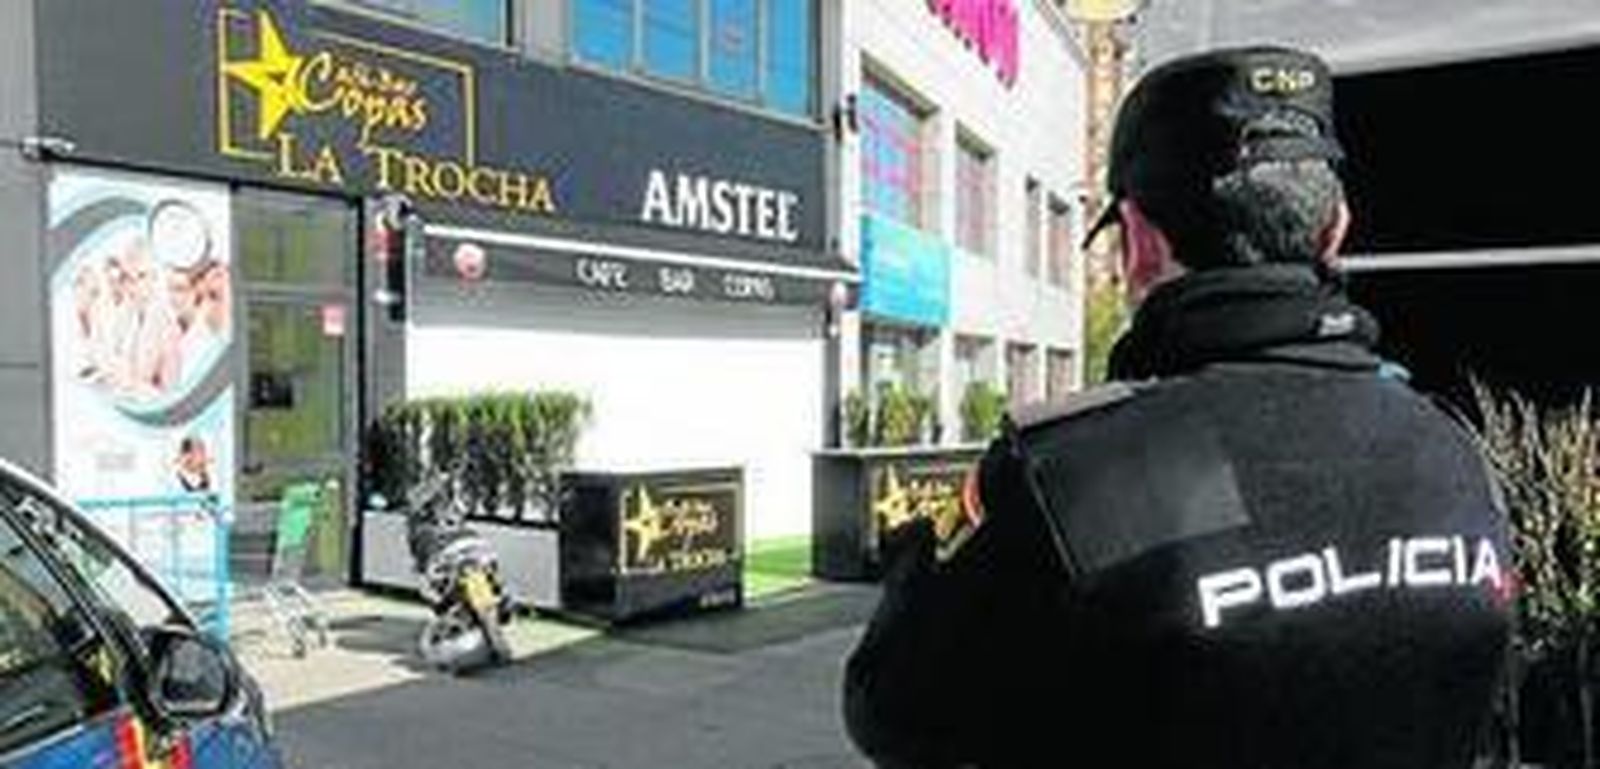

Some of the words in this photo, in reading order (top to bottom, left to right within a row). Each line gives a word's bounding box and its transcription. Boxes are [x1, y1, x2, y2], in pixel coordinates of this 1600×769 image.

[1251, 67, 1316, 92] CNP
[276, 133, 342, 184] LA
[364, 147, 556, 212] TROCHA
[641, 169, 799, 242] AMSTEL
[1197, 534, 1504, 629] POLICIA
